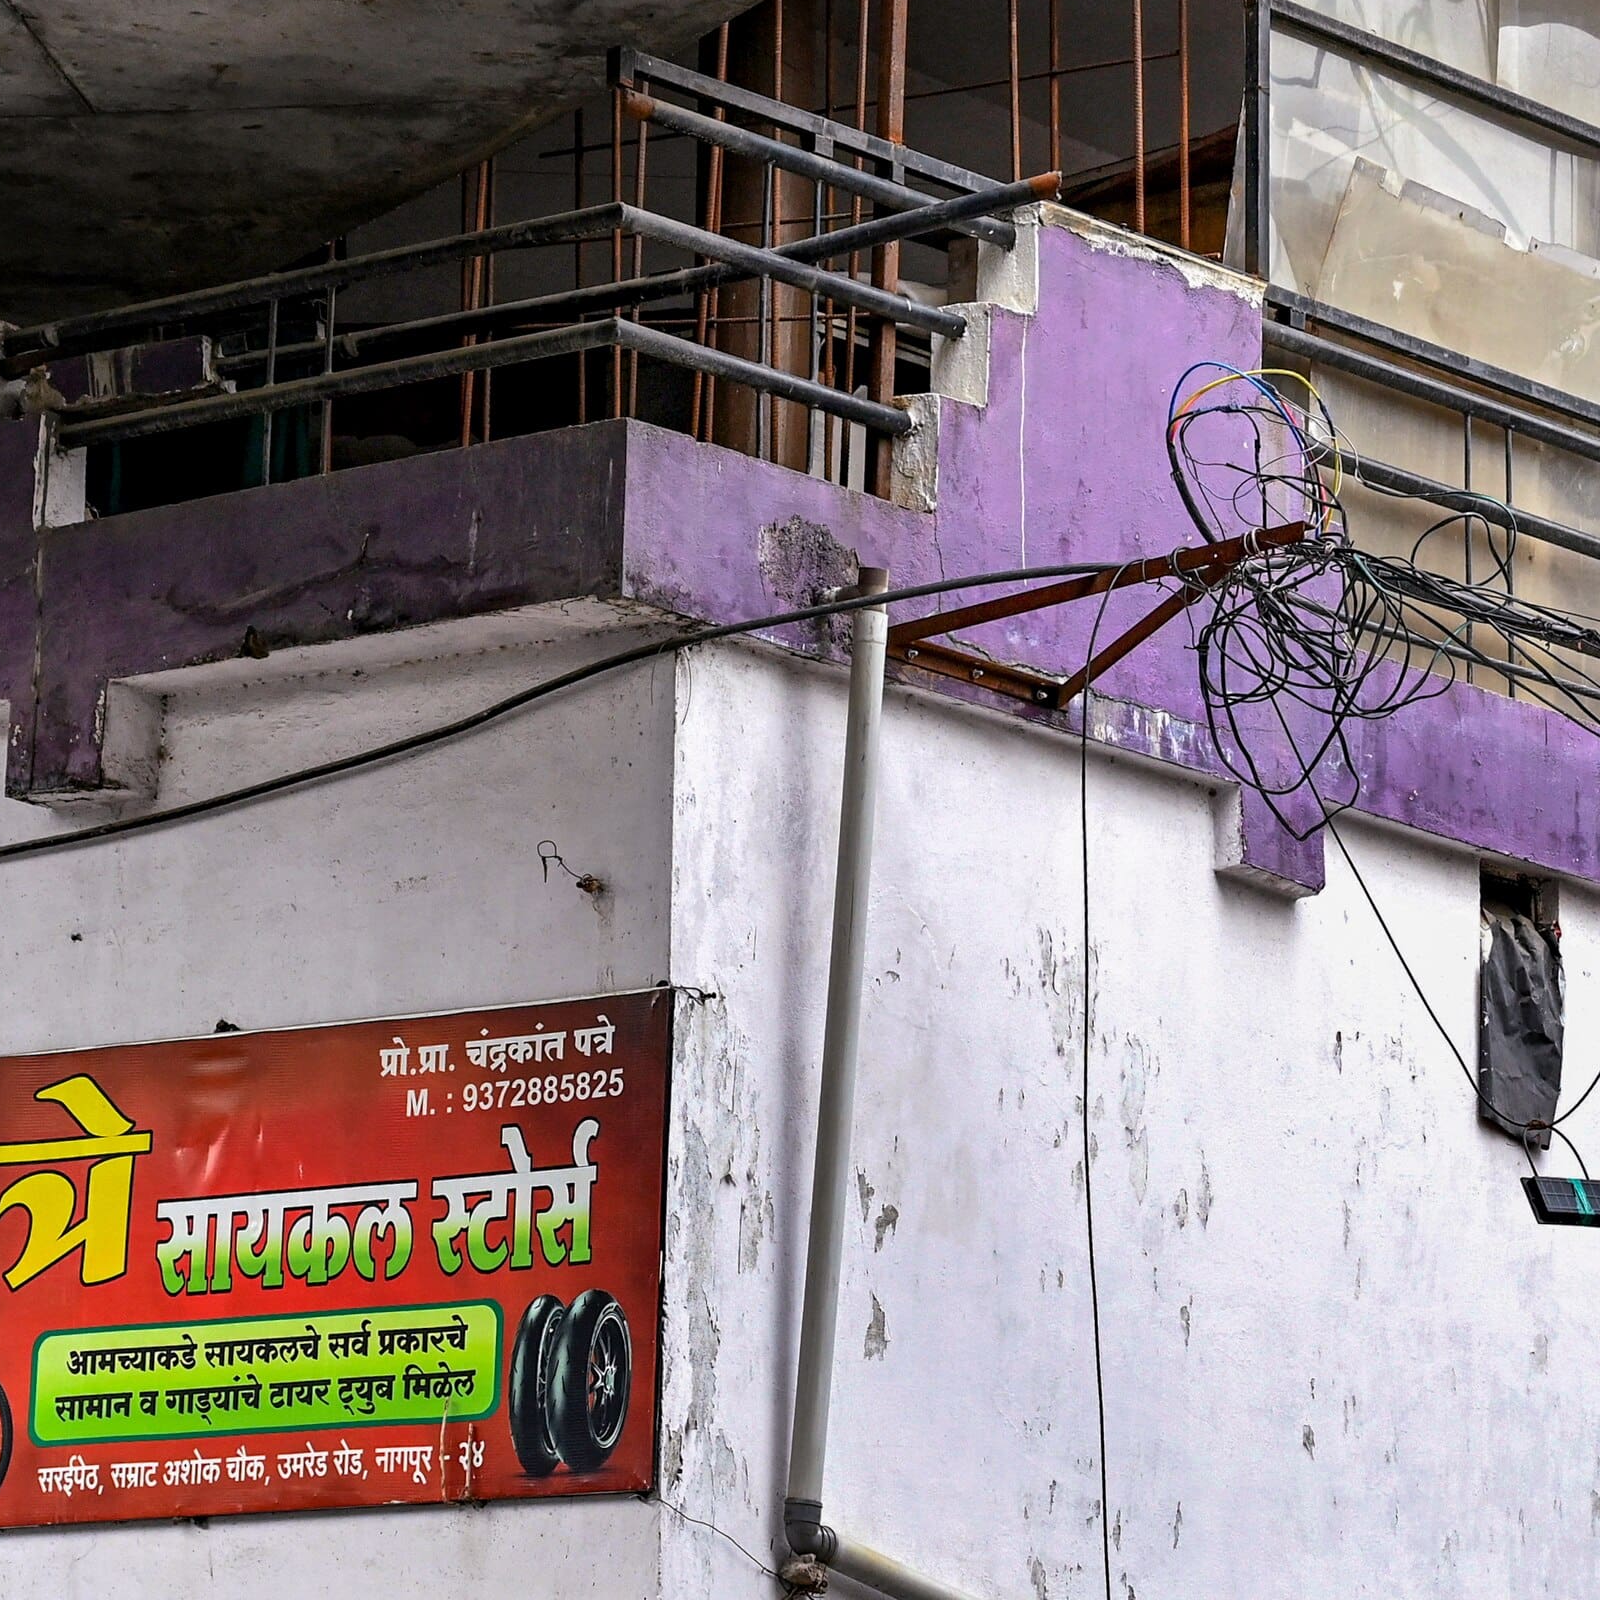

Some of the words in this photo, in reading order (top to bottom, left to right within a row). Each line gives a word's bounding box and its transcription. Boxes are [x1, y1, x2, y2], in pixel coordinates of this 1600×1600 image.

[379, 1037, 455, 1077] प्रो.प्रा.
[465, 1022, 567, 1073] चंद्रकांत
[573, 1014, 616, 1056] पत्रे
[462, 1067, 625, 1112] 9372885825
[156, 1179, 418, 1296] सायकल
[430, 1116, 600, 1275] स्टोर्स
[66, 1334, 197, 1375] आमच्याकडे
[204, 1325, 321, 1368] सायकलचे
[328, 1319, 371, 1359] सर्व
[378, 1314, 468, 1356] प्रकारचे
[55, 1392, 133, 1422] सामान
[139, 1390, 159, 1416] व
[165, 1374, 262, 1425] गाड्यांचे
[269, 1379, 331, 1409] टायर
[338, 1375, 396, 1415] ट्युब
[403, 1361, 476, 1400] मिळेल
[37, 1455, 104, 1497] सरईपेठ,
[110, 1461, 159, 1489] सम्राट
[162, 1448, 222, 1486] अशोक
[225, 1445, 270, 1486] चौक,
[276, 1441, 329, 1479] उमरेड
[333, 1438, 368, 1481] रोड,
[375, 1445, 433, 1485] नागपूर
